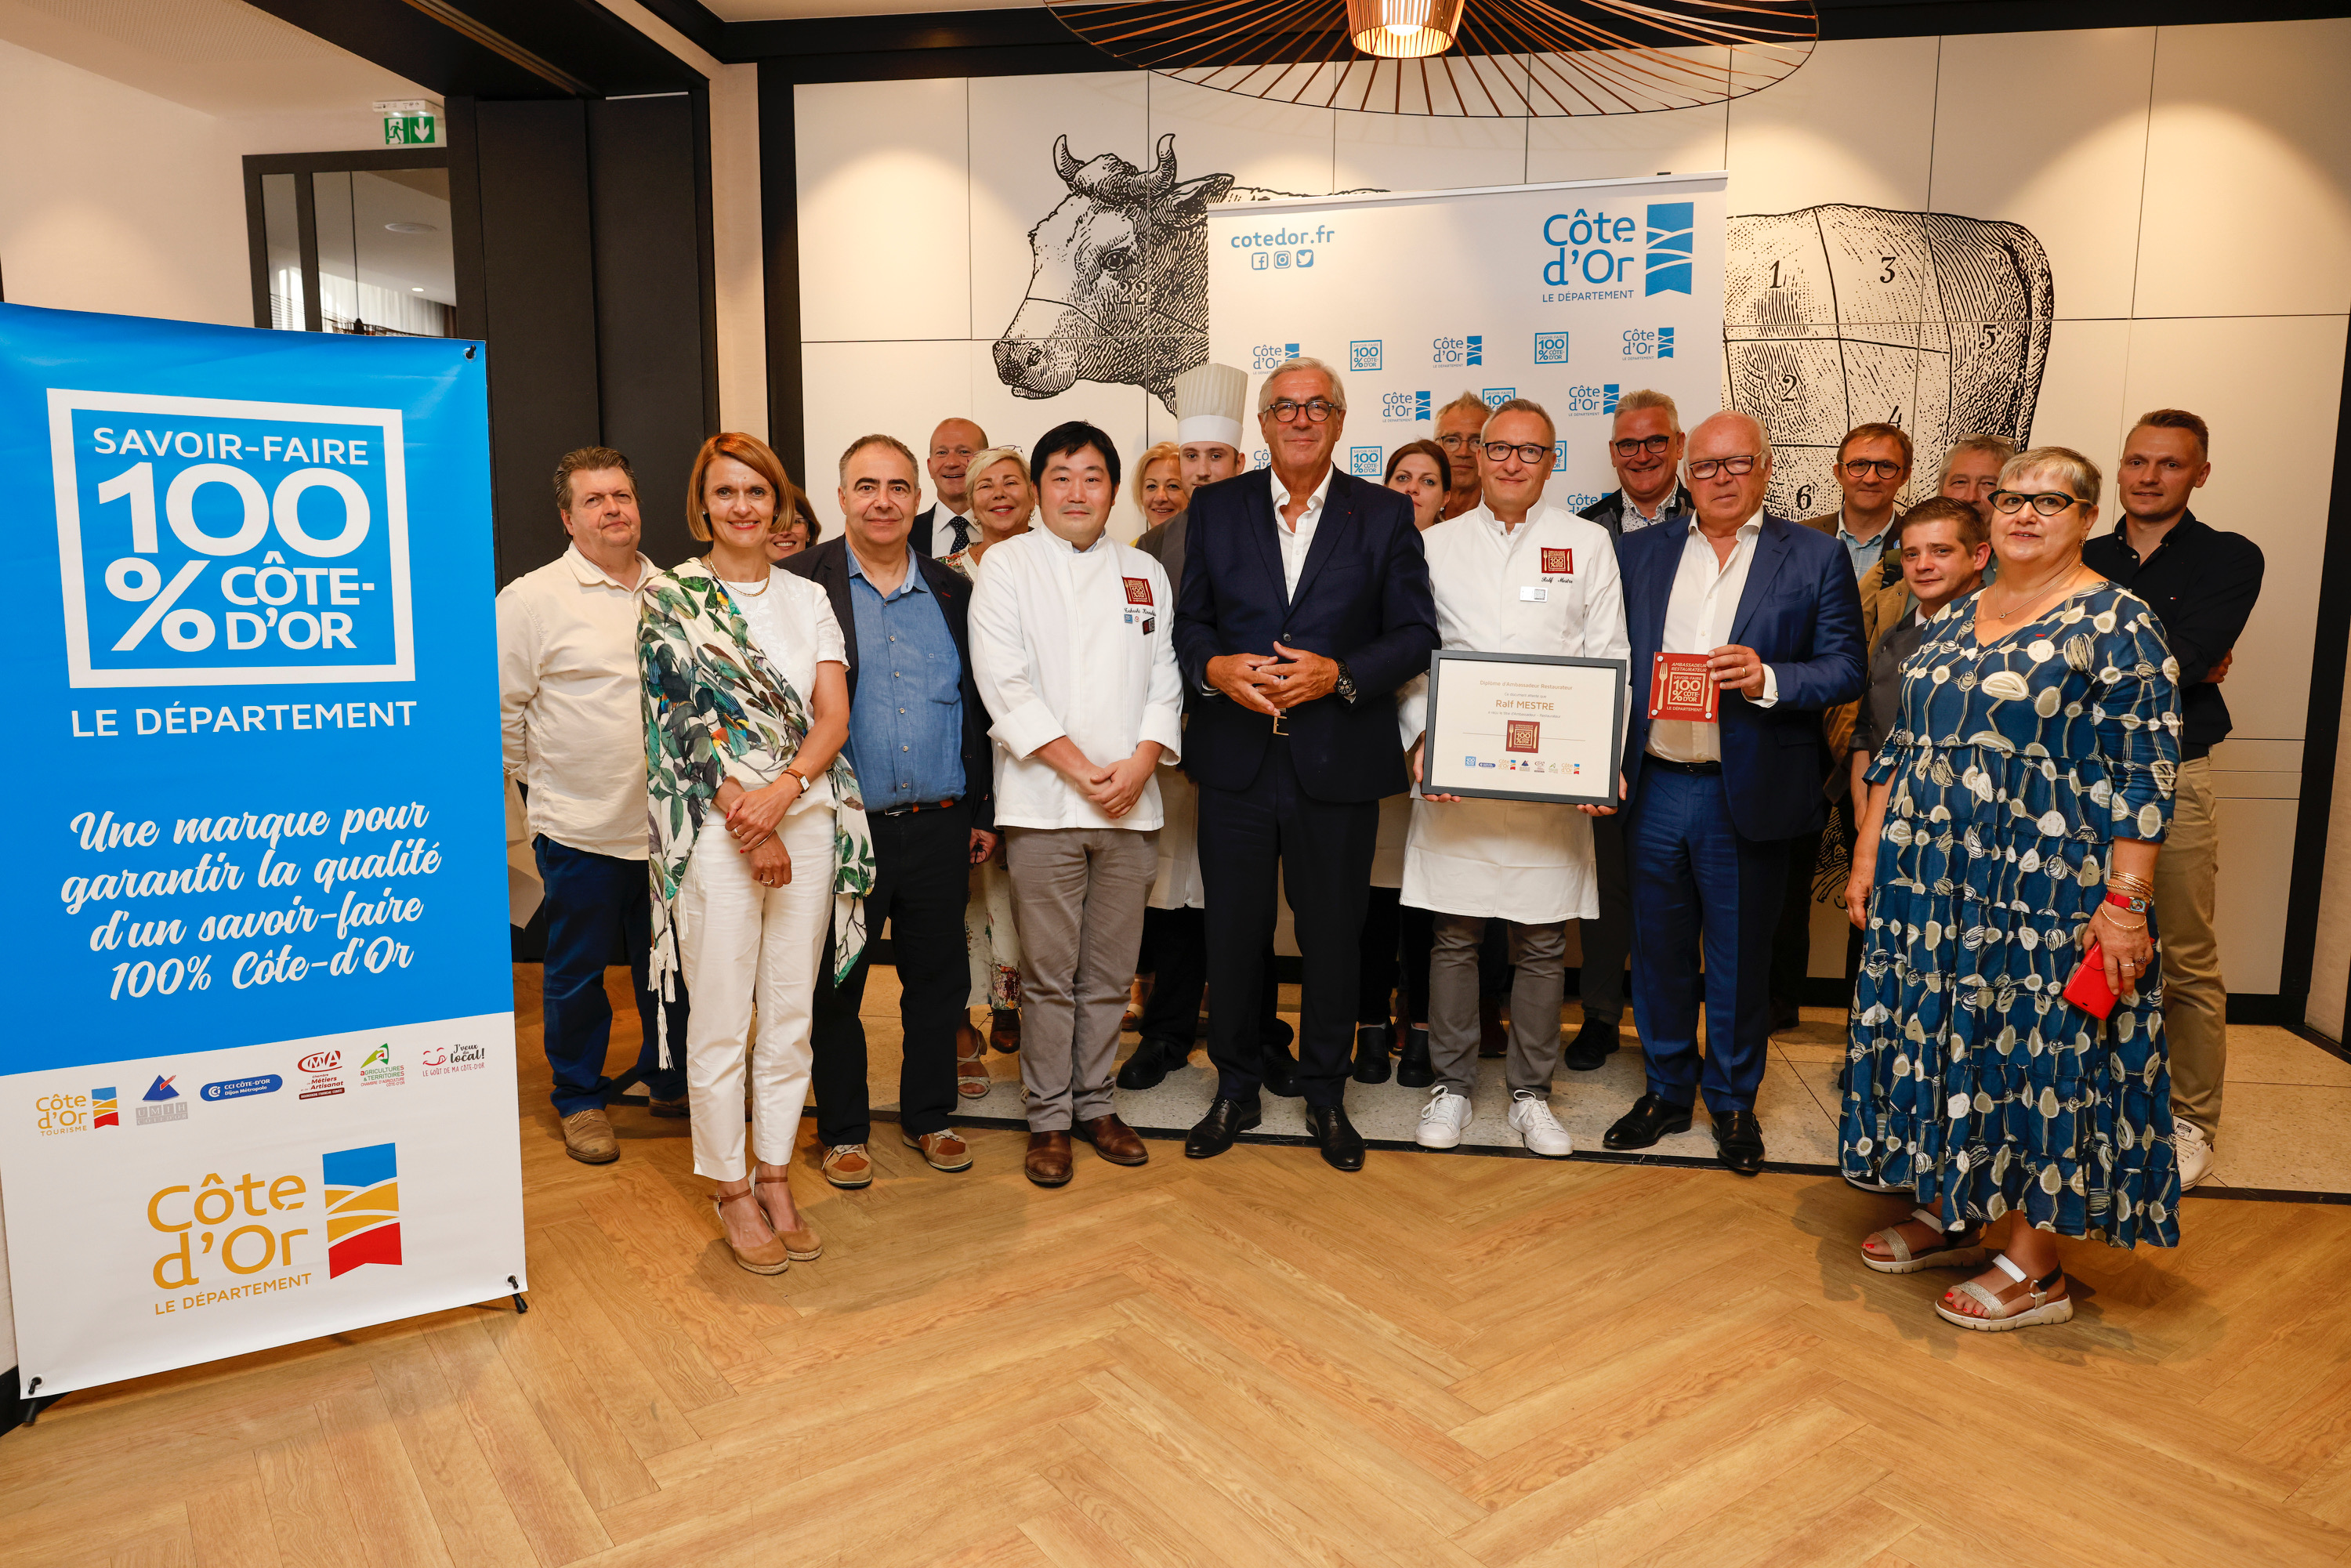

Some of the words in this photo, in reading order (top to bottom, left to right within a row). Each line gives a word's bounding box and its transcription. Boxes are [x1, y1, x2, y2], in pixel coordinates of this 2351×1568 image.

[1544, 208, 1636, 246] Côte
[1231, 225, 1335, 248] cotedor.fr
[1543, 248, 1634, 286] d'Or
[1880, 257, 1896, 284] 3
[1769, 260, 1782, 288] 1
[1543, 294, 1554, 302] LE
[1558, 291, 1634, 302] DÉPARTEMENT
[1623, 329, 1654, 342] Côte
[1979, 324, 1996, 351] 5
[1433, 337, 1463, 349] Côte
[1538, 339, 1564, 349] 100
[1623, 342, 1654, 355] d'Or
[1253, 345, 1281, 357] Côte
[1354, 347, 1378, 357] 100
[1433, 349, 1463, 362] d'Or
[1538, 350, 1549, 360] %
[1253, 357, 1281, 369] d'Or
[1354, 357, 1363, 368] %
[1569, 386, 1600, 398] Côte
[1782, 375, 1798, 402] 2
[1382, 392, 1412, 404] Côte
[1487, 395, 1512, 405] 100
[1569, 398, 1599, 411] d'Or
[1382, 404, 1412, 417] d'Or
[94, 428, 368, 465] SAVOIR-FAIRE
[1354, 453, 1378, 463] 100
[1354, 463, 1363, 473] %
[1567, 494, 1598, 506] Côte
[1796, 486, 1811, 509] 6
[98, 462, 371, 557] 100
[105, 557, 216, 652] %
[221, 551, 375, 606] CÔTE-
[226, 607, 357, 650] D'OR
[1673, 679, 1701, 691] 100
[1672, 690, 1683, 701] %
[1496, 700, 1514, 708] Ralf
[1517, 701, 1554, 711] MESTRE
[71, 709, 118, 737] LE
[136, 701, 417, 735] DÉPARTEMENT
[70, 811, 160, 853] Une
[173, 809, 330, 849] marque
[341, 801, 429, 843] pour
[60, 853, 245, 914] garantir
[257, 849, 300, 888] la
[314, 838, 441, 893] qualité
[90, 910, 187, 951] d'un
[198, 887, 424, 942] savoir-faire
[110, 954, 212, 1001] 100%
[232, 935, 415, 990] Côte-d'Or
[454, 1044, 478, 1053] J'veux
[451, 1048, 484, 1063] local!
[368, 1071, 404, 1081] TERRITOIRES
[236, 1078, 270, 1088] CÔTE-D'OR
[240, 1085, 267, 1094] Métropole
[310, 1081, 343, 1090] Artisanat
[36, 1094, 86, 1112] Côte
[138, 1103, 186, 1116] UMIH
[38, 1110, 87, 1129] d'Or
[40, 1125, 87, 1136] TOURISME
[147, 1172, 306, 1233] Côte
[153, 1225, 309, 1290] d'Or
[155, 1299, 176, 1316] LE
[183, 1273, 312, 1310] DÉPARTEMENT
